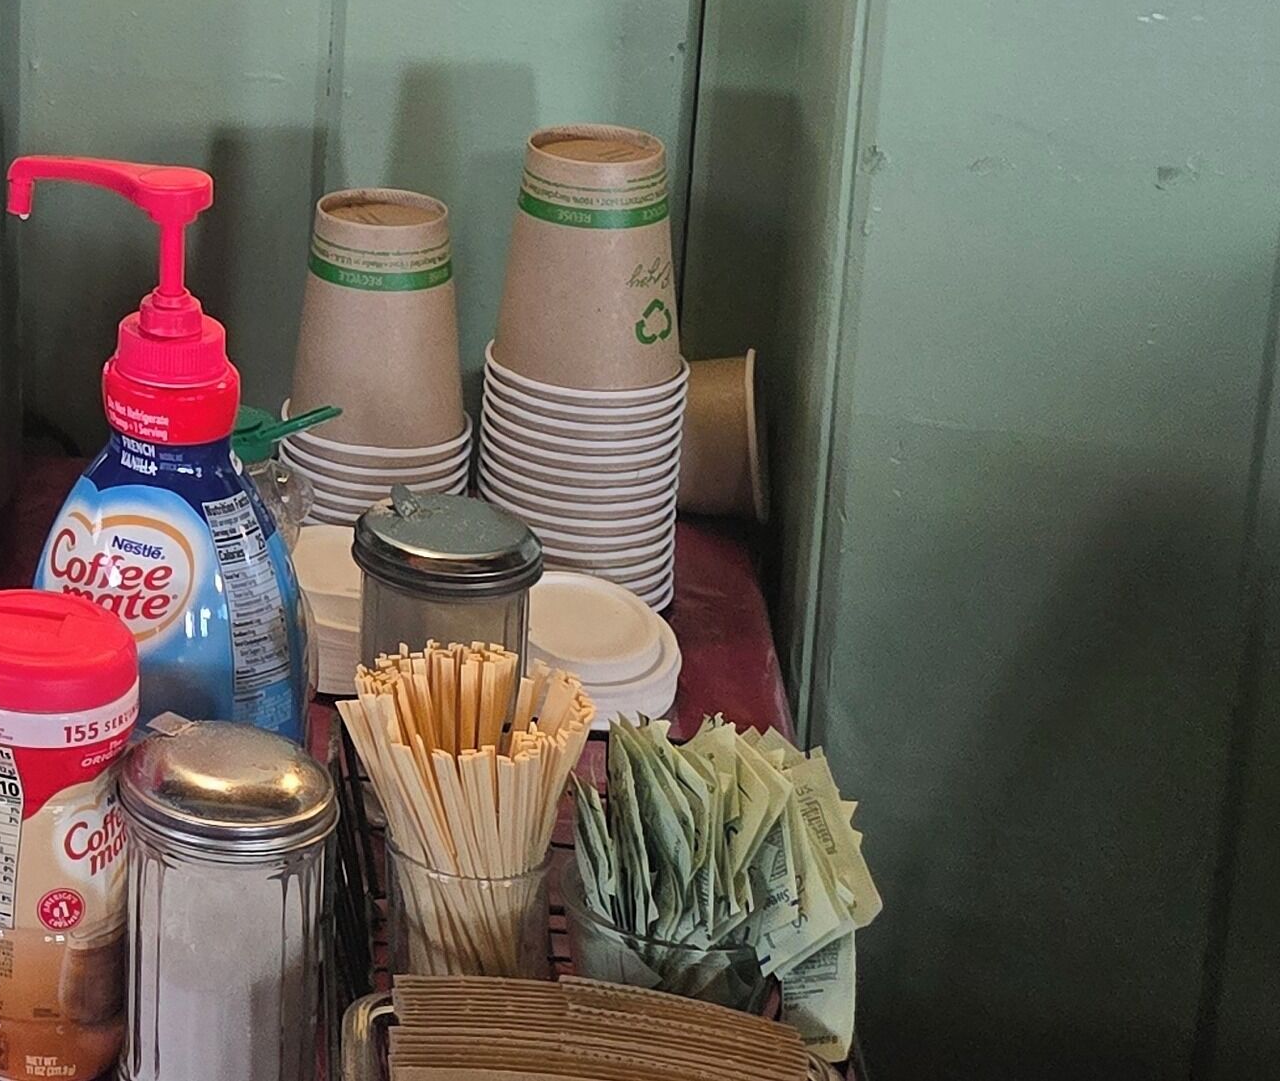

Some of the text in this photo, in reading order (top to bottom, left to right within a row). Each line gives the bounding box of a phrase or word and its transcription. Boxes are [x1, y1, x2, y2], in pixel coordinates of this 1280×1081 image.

[338, 271, 383, 287] RECYCLE
[50, 528, 173, 591] Coffee
[64, 721, 100, 744] 155
[0, 780, 20, 797] 10
